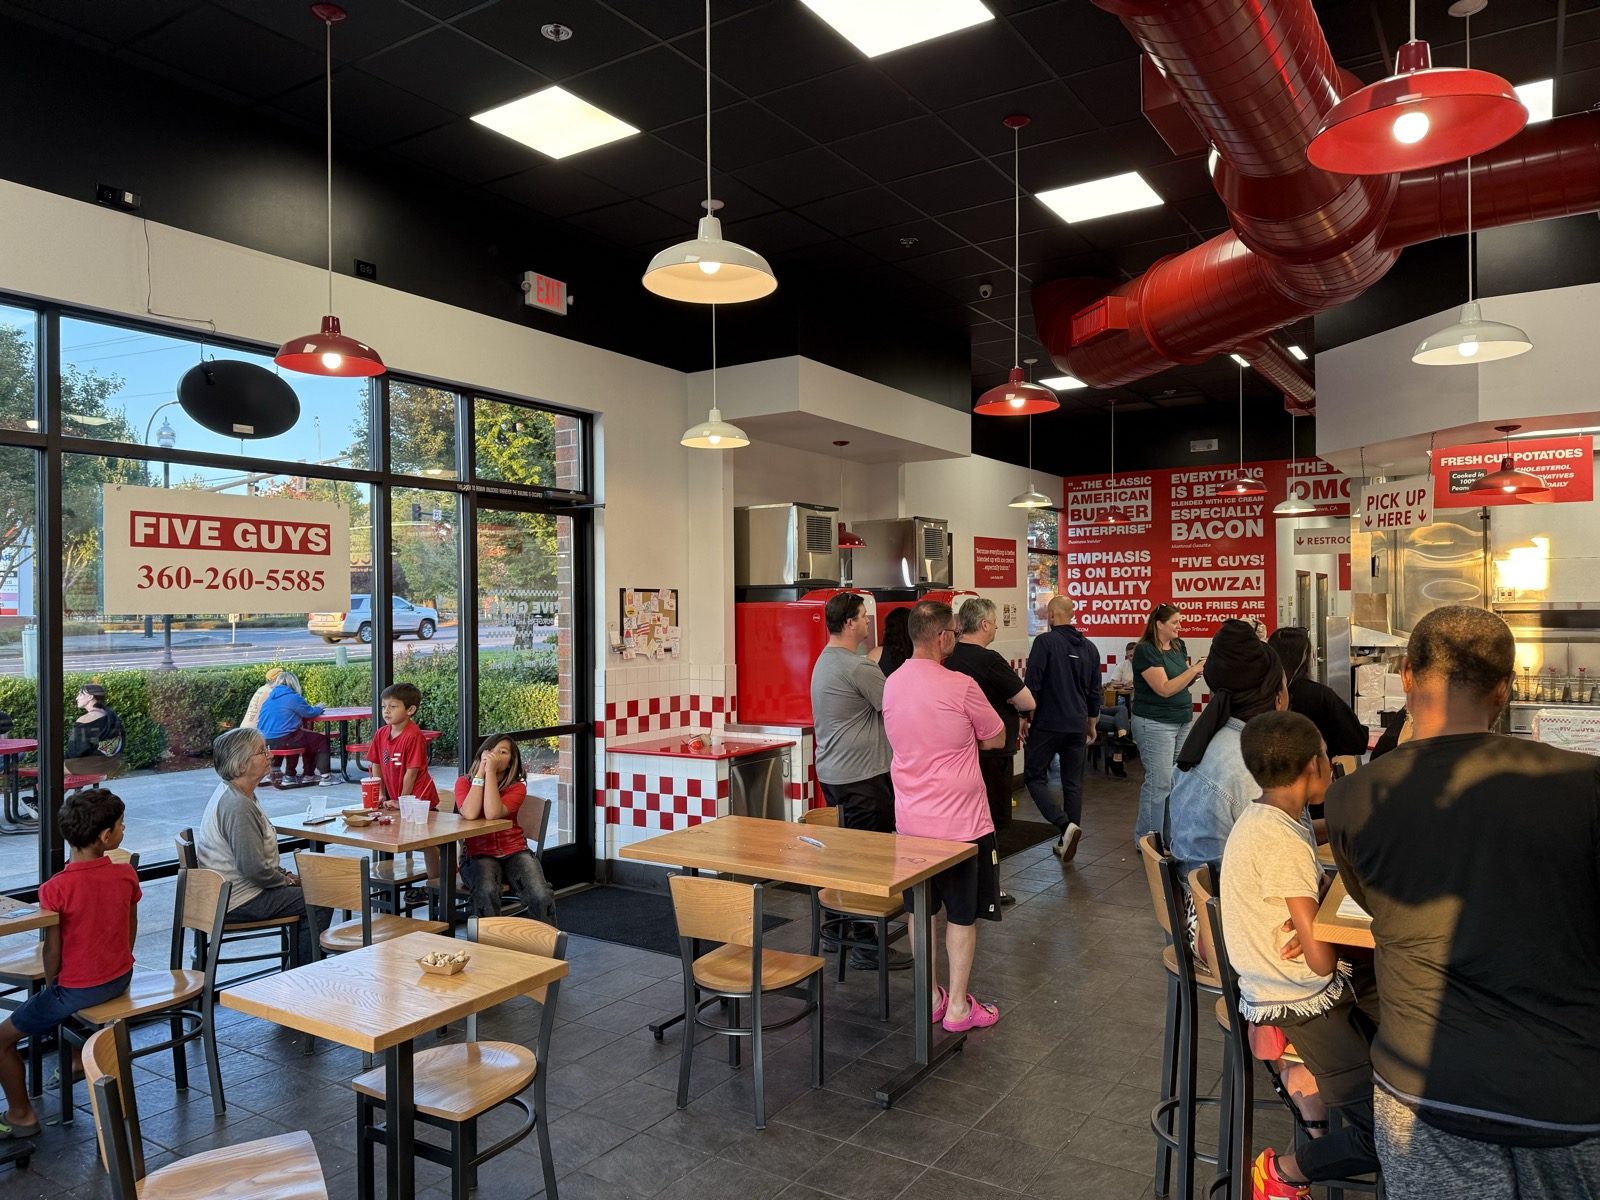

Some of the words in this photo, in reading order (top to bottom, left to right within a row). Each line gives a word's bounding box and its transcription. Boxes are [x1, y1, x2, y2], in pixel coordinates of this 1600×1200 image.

[537, 275, 562, 310] EXIT
[1440, 453, 1484, 466] FRESH
[1513, 448, 1583, 462] POTATOES
[1287, 461, 1328, 474] "THE
[1514, 464, 1571, 472] CHOLESTEROL
[1105, 476, 1152, 487] CLASSIC
[1171, 467, 1264, 484] EVERYTHNG
[1070, 490, 1149, 505] AMERICAN
[1171, 485, 1187, 499] IS
[1367, 491, 1400, 511] PICK
[1406, 488, 1426, 507] UP
[1171, 499, 1203, 507] BLENDED
[1238, 495, 1264, 503] CREAM
[1070, 505, 1149, 522] BURER
[1171, 505, 1264, 520] ESPECIALLY
[1377, 510, 1412, 528] HERE
[134, 515, 221, 547] FIVE
[233, 522, 328, 553] GUYS
[1068, 523, 1152, 537] ENTERPRISE"
[1171, 518, 1264, 541] BACON
[1067, 550, 1151, 565] EMPHASIS
[1171, 556, 1212, 568] "FIVE
[1217, 554, 1265, 567] GUYS!
[136, 564, 325, 592] 360-260-5585
[1067, 568, 1081, 579] IS
[1085, 567, 1106, 578] ON
[1111, 566, 1151, 578] BOTH
[1068, 580, 1151, 597] QUALITY
[1174, 576, 1261, 592] WOWZA!
[1092, 599, 1151, 611] POTATO
[1173, 601, 1203, 610] YOUR
[1206, 601, 1239, 609] FRIES
[1241, 600, 1265, 609] ARE
[1081, 613, 1150, 625] QUANTITY
